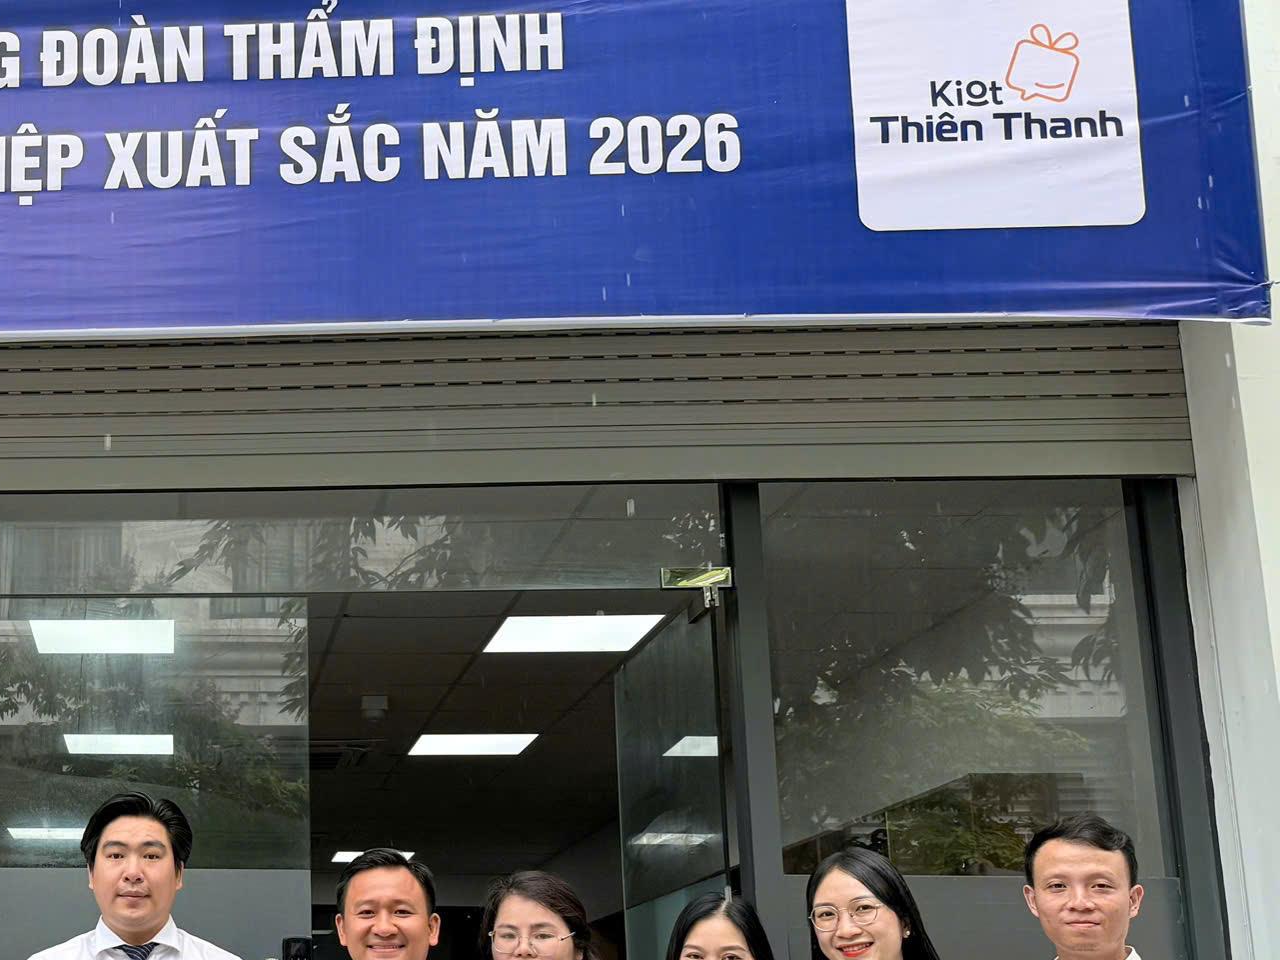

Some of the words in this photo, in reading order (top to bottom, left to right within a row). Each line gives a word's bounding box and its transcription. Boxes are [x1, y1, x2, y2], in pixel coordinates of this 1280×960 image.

[40, 14, 204, 87] ĐOÀN
[223, 0, 394, 81] THẨM
[414, 12, 564, 88] ĐỊNH
[929, 79, 1003, 107] Kiot
[103, 108, 259, 190] XUẤT
[279, 103, 401, 185] SẮC
[423, 107, 567, 181] NĂM
[588, 112, 741, 177] 2026
[869, 111, 983, 144] Thiên
[992, 110, 1124, 141] Thanh
